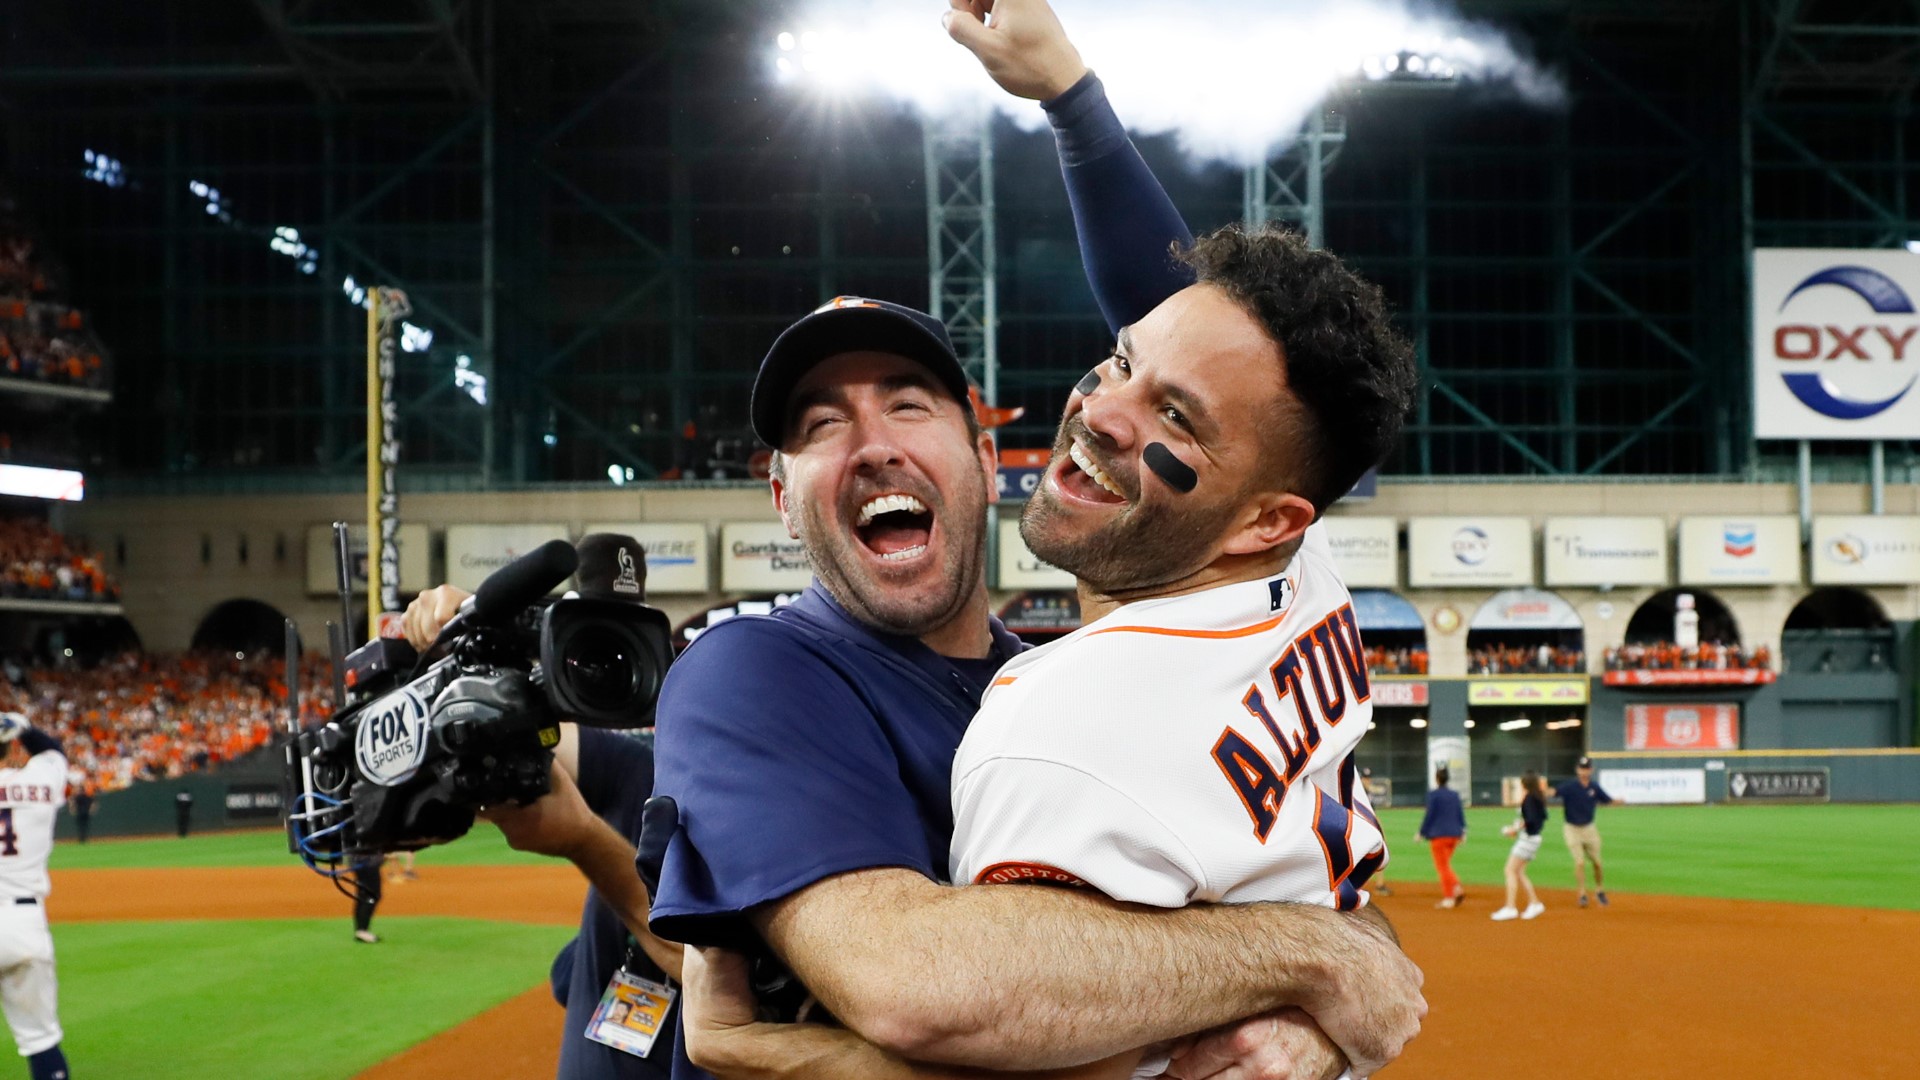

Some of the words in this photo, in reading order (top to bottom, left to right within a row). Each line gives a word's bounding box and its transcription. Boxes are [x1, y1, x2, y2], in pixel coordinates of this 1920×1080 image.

[1774, 325, 1919, 361] OXY
[447, 705, 475, 717] Canon
[369, 701, 410, 753] FOX
[372, 740, 414, 769] SPORTS
[984, 867, 1087, 886] OUSTON
